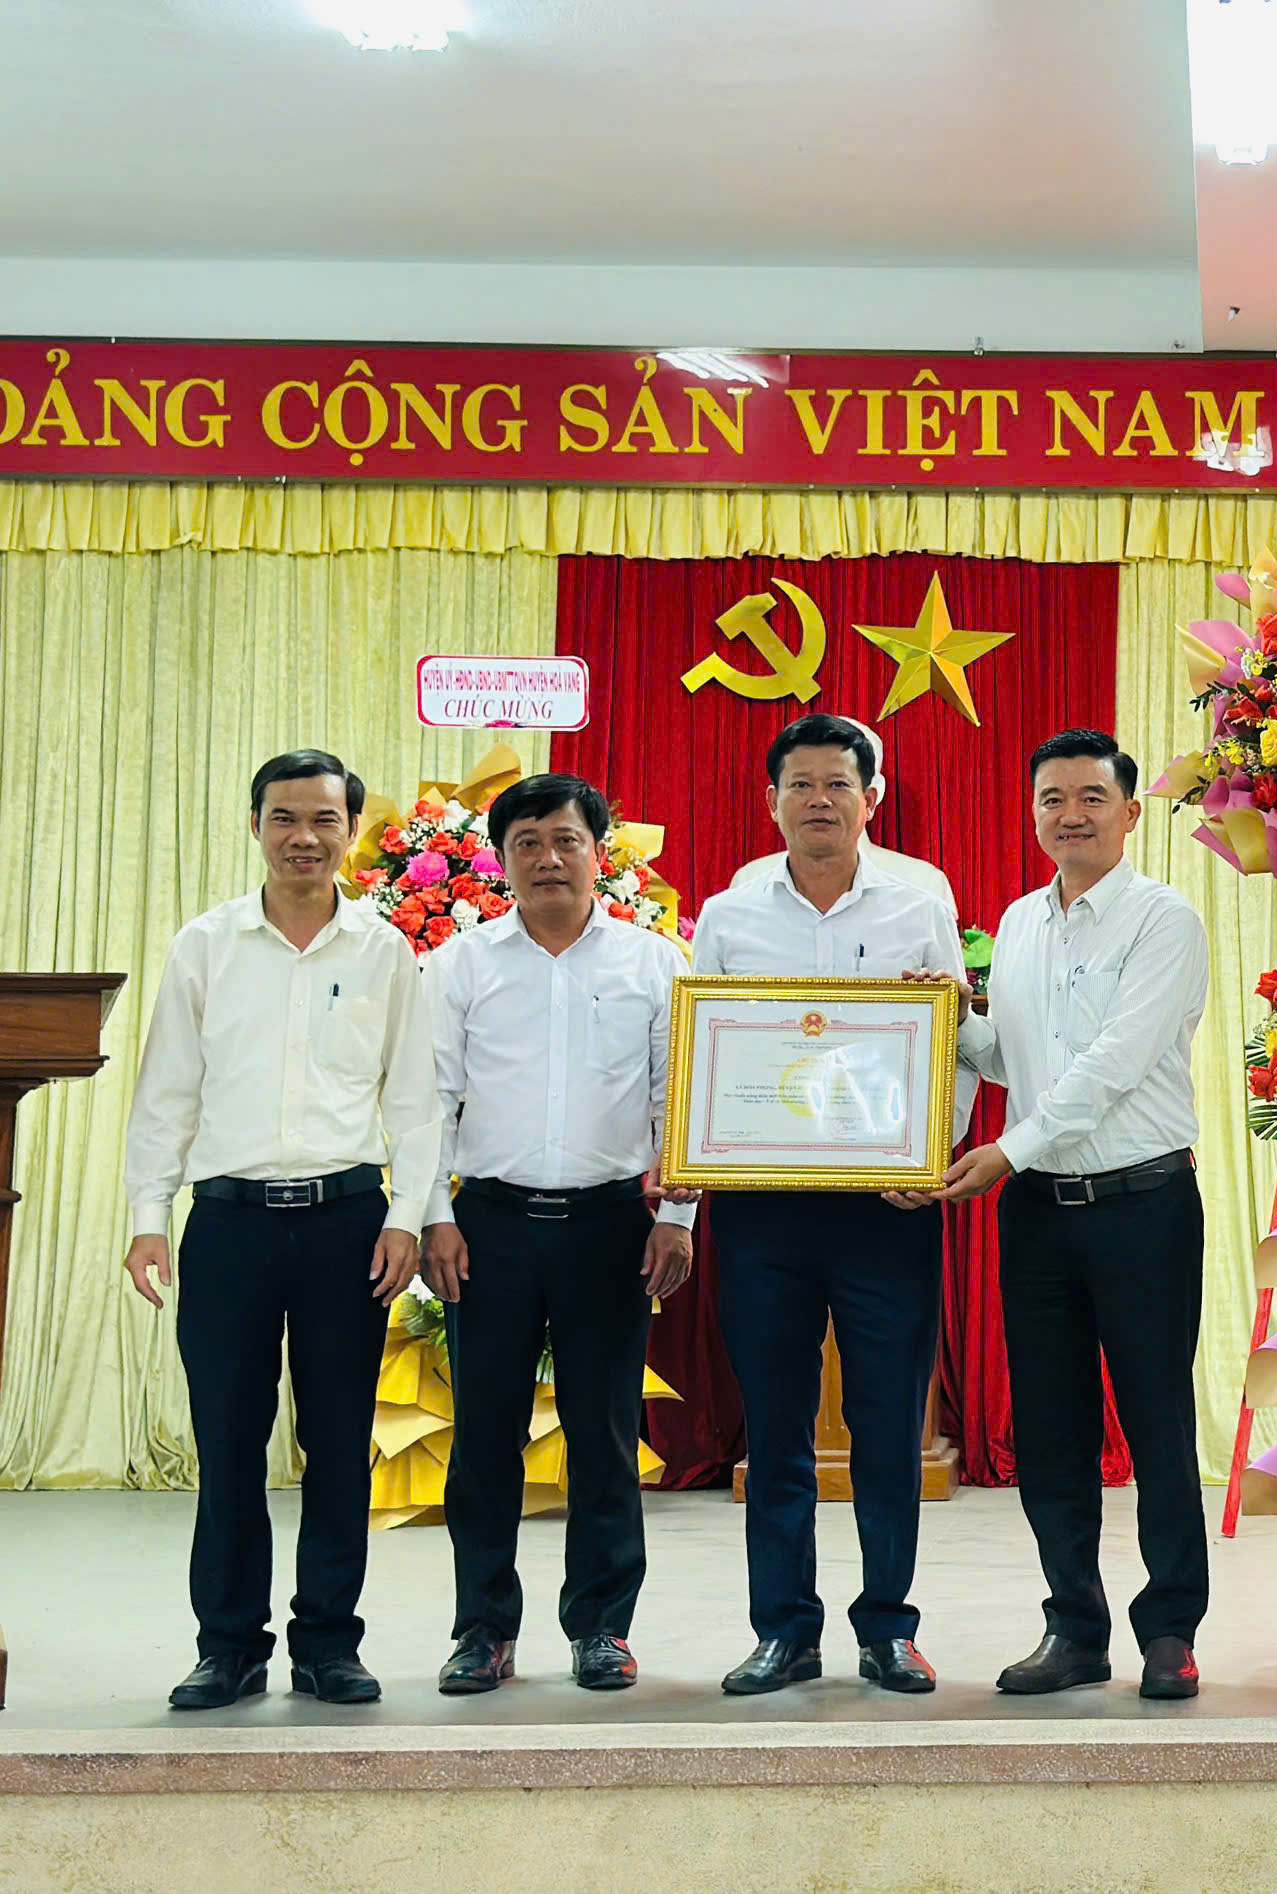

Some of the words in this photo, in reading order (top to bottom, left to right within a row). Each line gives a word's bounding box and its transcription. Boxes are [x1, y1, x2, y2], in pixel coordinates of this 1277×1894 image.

[262, 359, 527, 466] CỘNG
[559, 357, 752, 454] SẢN
[785, 369, 1020, 471] VIỆT
[1045, 389, 1269, 457] NAM
[444, 694, 496, 719] CHÚC
[500, 694, 555, 719] MỪNG
